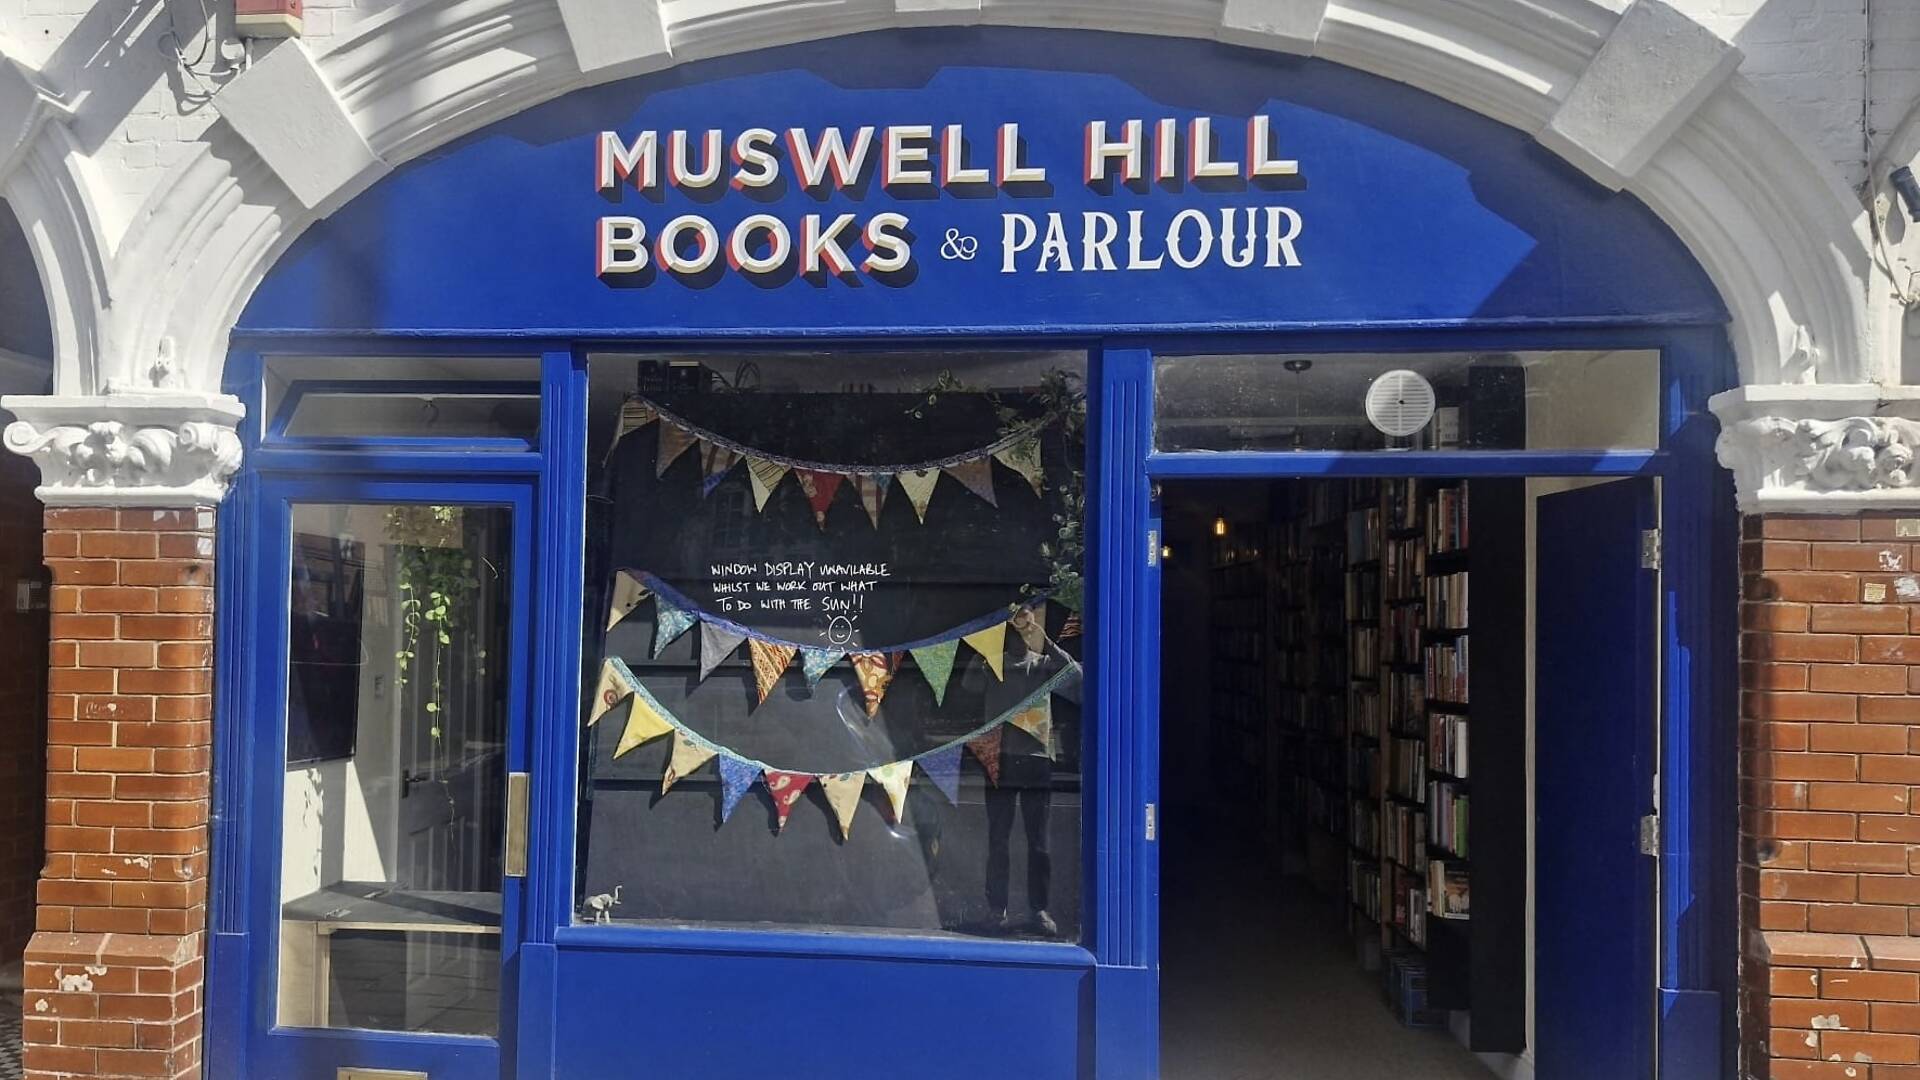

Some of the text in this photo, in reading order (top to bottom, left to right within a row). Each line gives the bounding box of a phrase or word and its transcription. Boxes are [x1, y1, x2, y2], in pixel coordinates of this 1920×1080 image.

[597, 114, 1302, 195] MUSWELL HILL
[597, 207, 1303, 280] BOOKS & PARLOUR
[711, 562, 757, 577] WINDOW
[765, 561, 815, 579] DISPLAY
[713, 580, 878, 593] WHILST WE WORK OUT WHAT
[760, 598, 786, 611] WITH
[791, 598, 812, 611] THE
